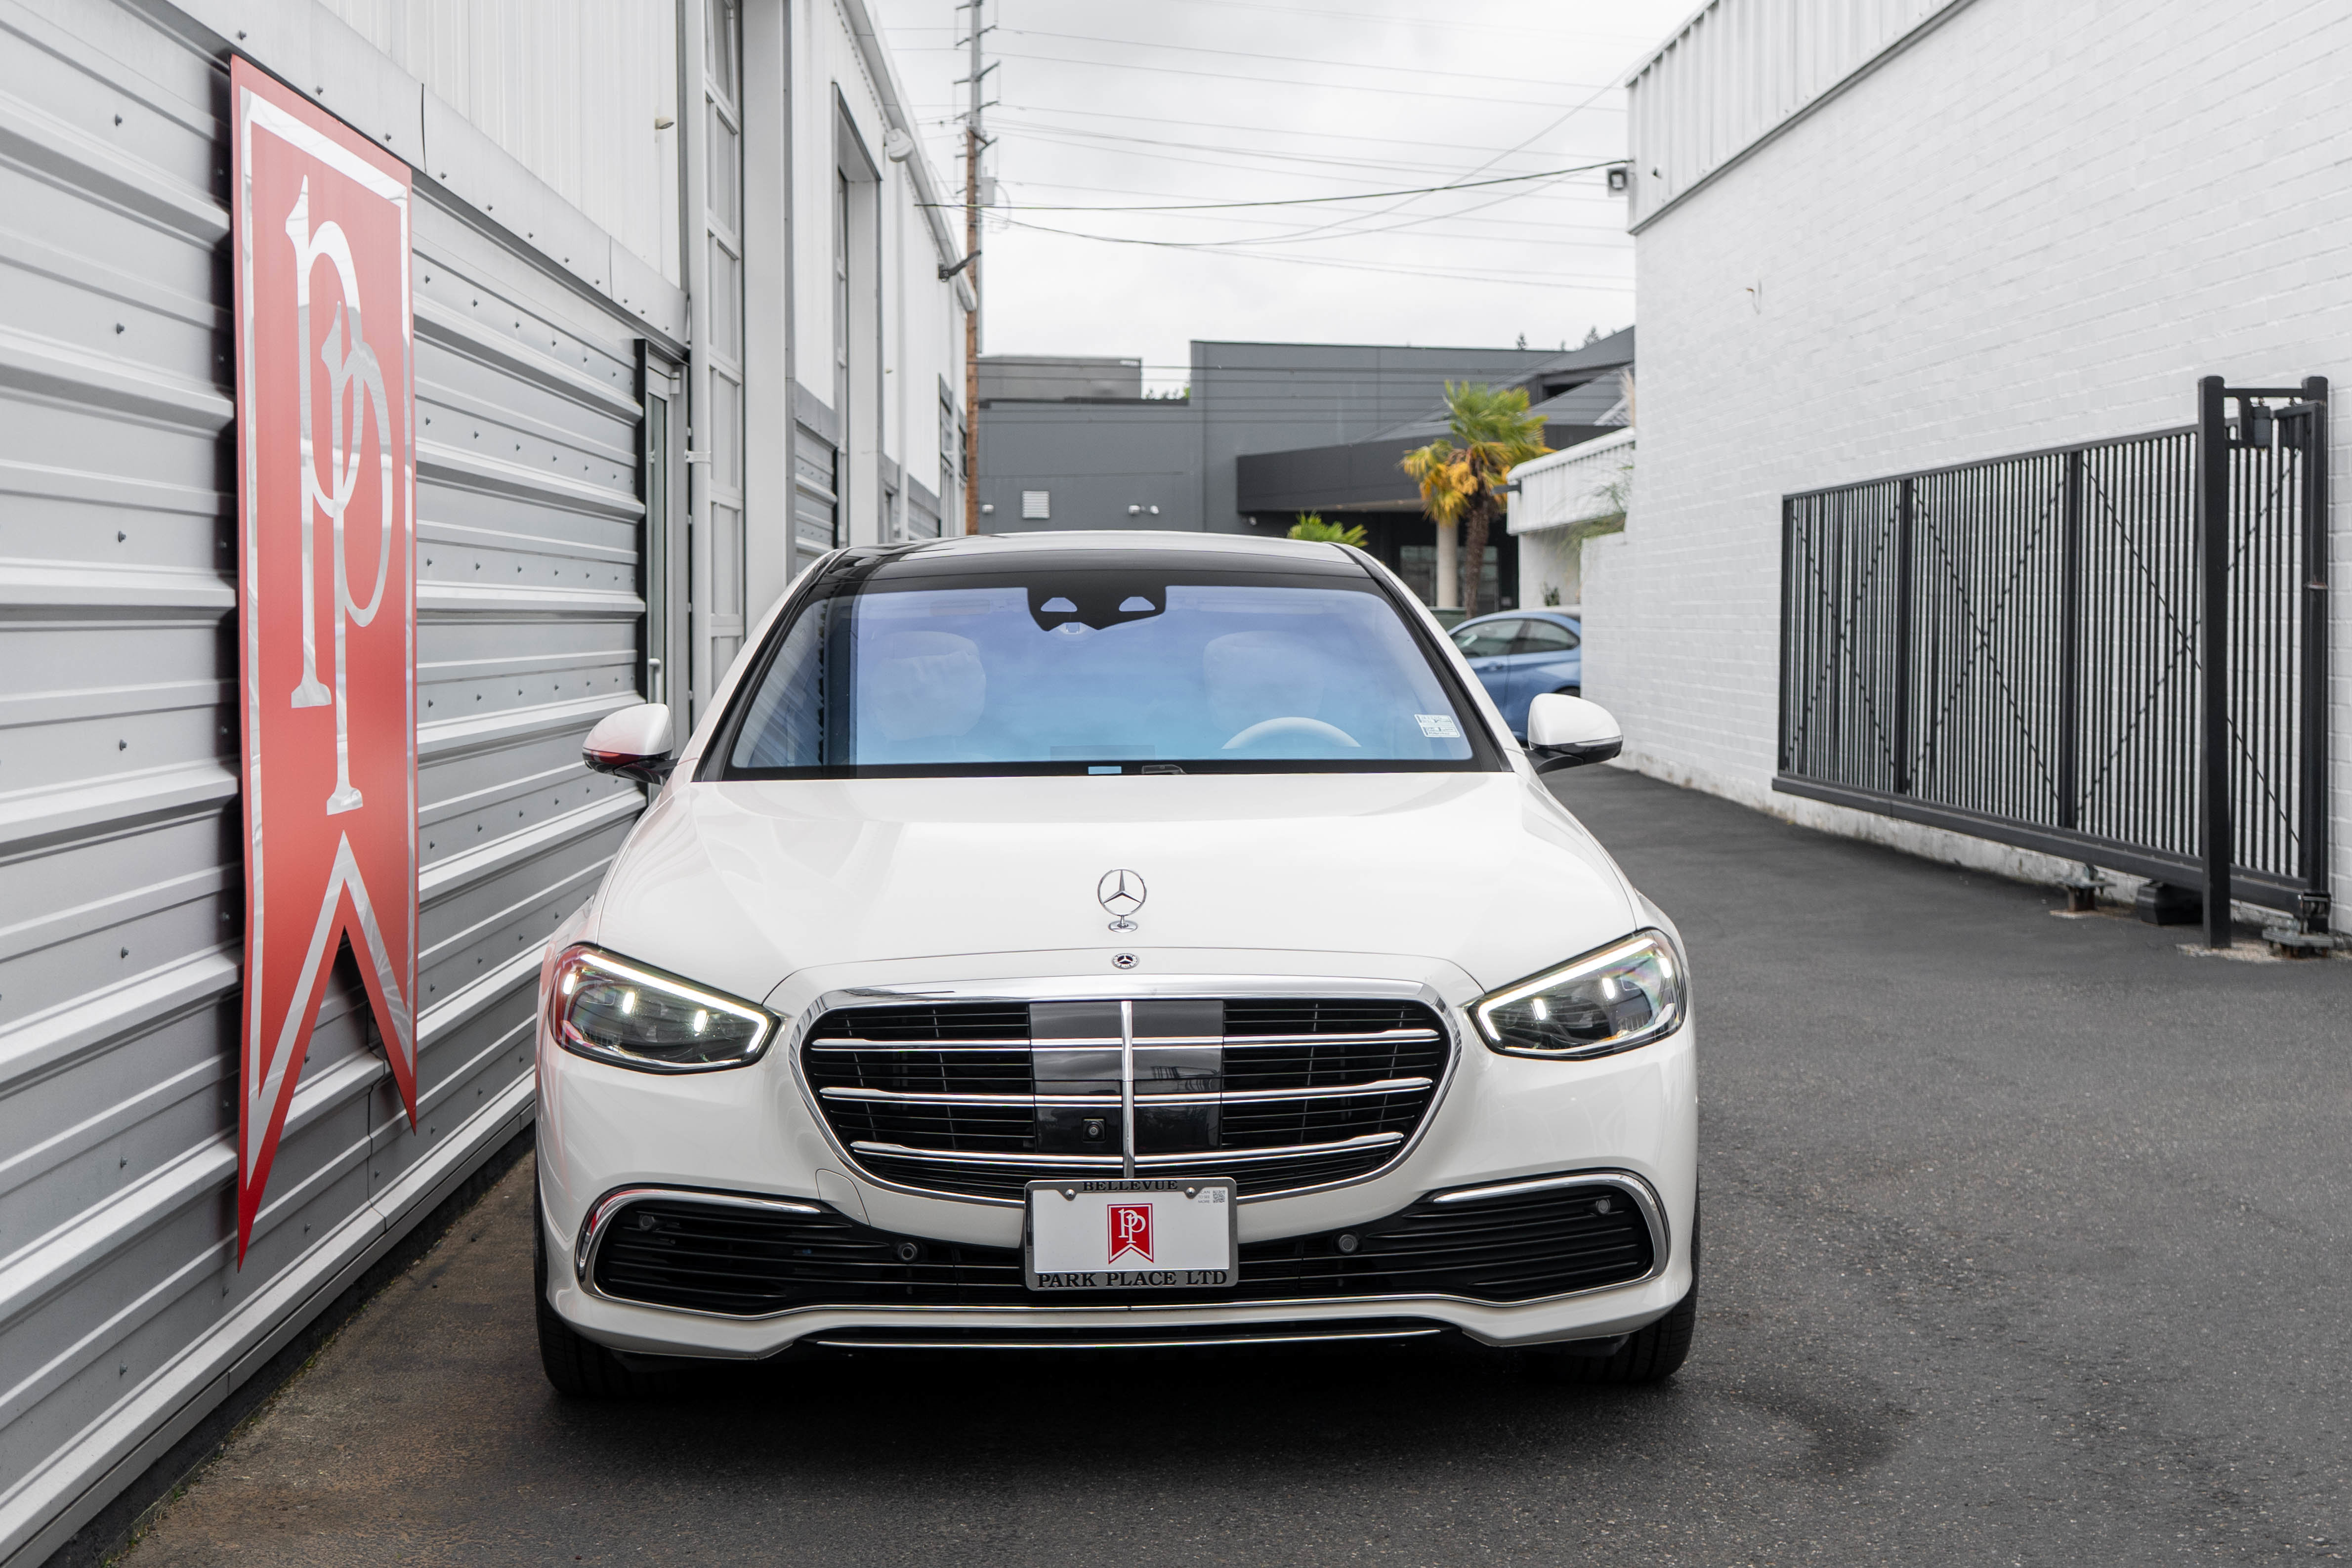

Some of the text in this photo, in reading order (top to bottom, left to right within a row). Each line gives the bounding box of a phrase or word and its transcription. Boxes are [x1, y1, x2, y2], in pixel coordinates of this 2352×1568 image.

[1083, 1181, 1178, 1191] BELLEVUE
[1038, 1271, 1227, 1288] PARK PLACE LTD
